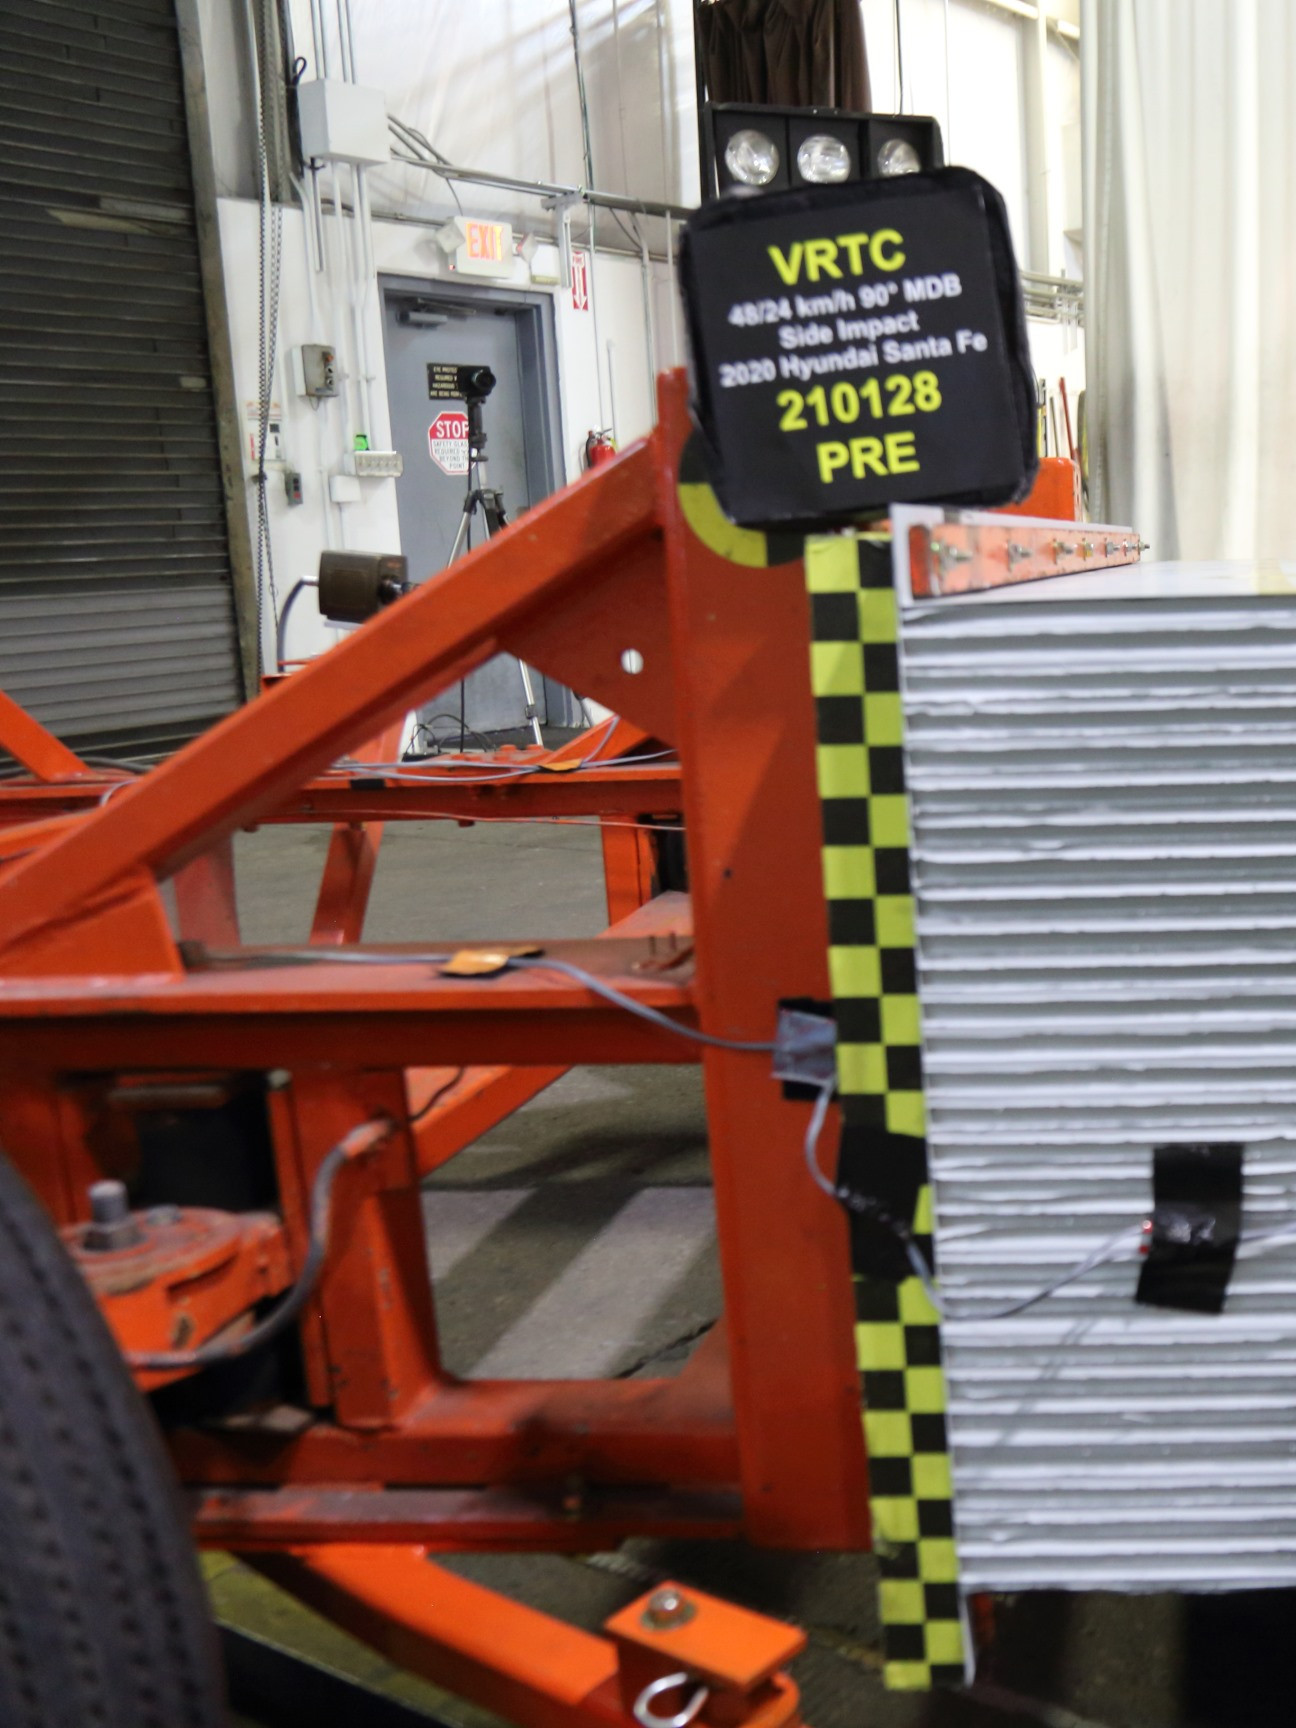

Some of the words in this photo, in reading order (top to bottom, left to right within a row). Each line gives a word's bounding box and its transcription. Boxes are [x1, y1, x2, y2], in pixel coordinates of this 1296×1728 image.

[465, 222, 503, 262] EXIT
[767, 228, 906, 286] VRTC
[728, 295, 793, 327] 48/24
[794, 287, 856, 318] km/h
[858, 281, 898, 309] 90°
[902, 272, 962, 302] MDB
[778, 321, 834, 350] Side
[836, 309, 920, 341] Impact
[718, 357, 777, 388] 2020
[778, 341, 879, 382] Hyundai
[881, 335, 953, 364] Santa
[955, 328, 988, 355] Fe
[776, 370, 942, 432] 210128
[436, 420, 469, 438] STOP
[816, 431, 920, 483] PRE
